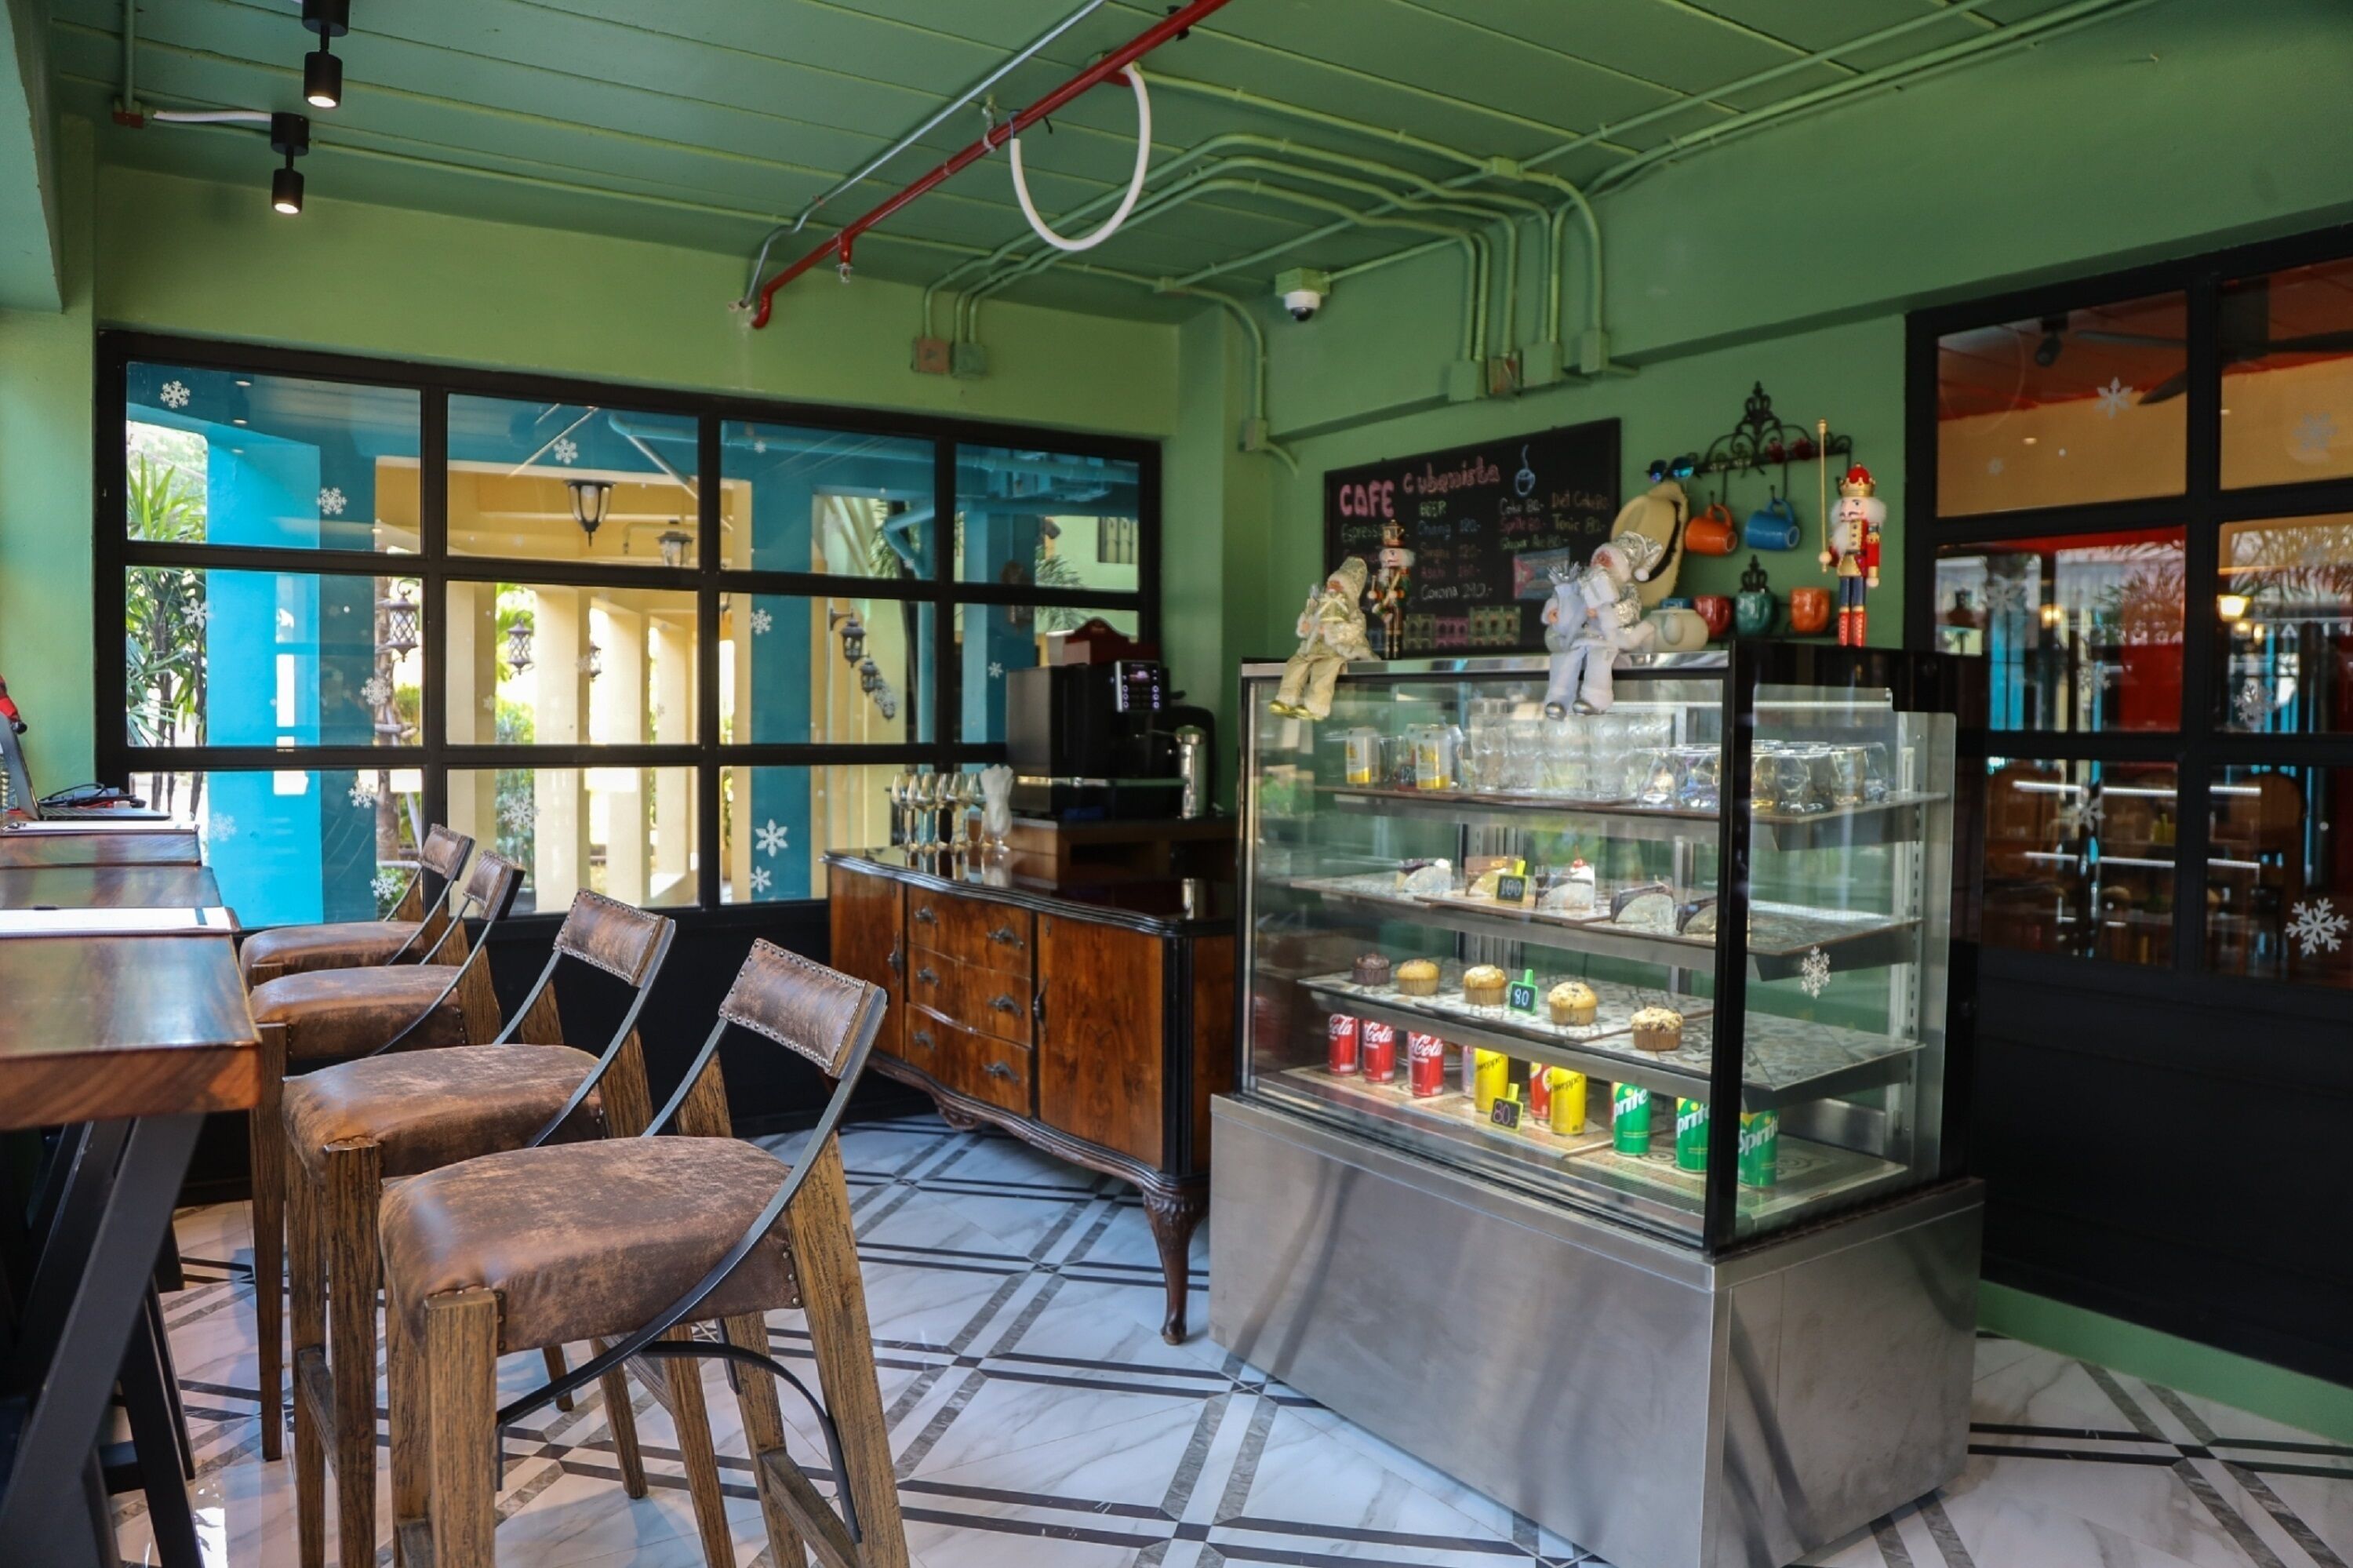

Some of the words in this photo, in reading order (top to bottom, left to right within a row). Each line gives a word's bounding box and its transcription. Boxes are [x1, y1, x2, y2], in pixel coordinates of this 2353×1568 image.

[1339, 480, 1395, 518] CAFE
[1420, 584, 1459, 601] Corona
[1613, 1087, 1649, 1124] prite
